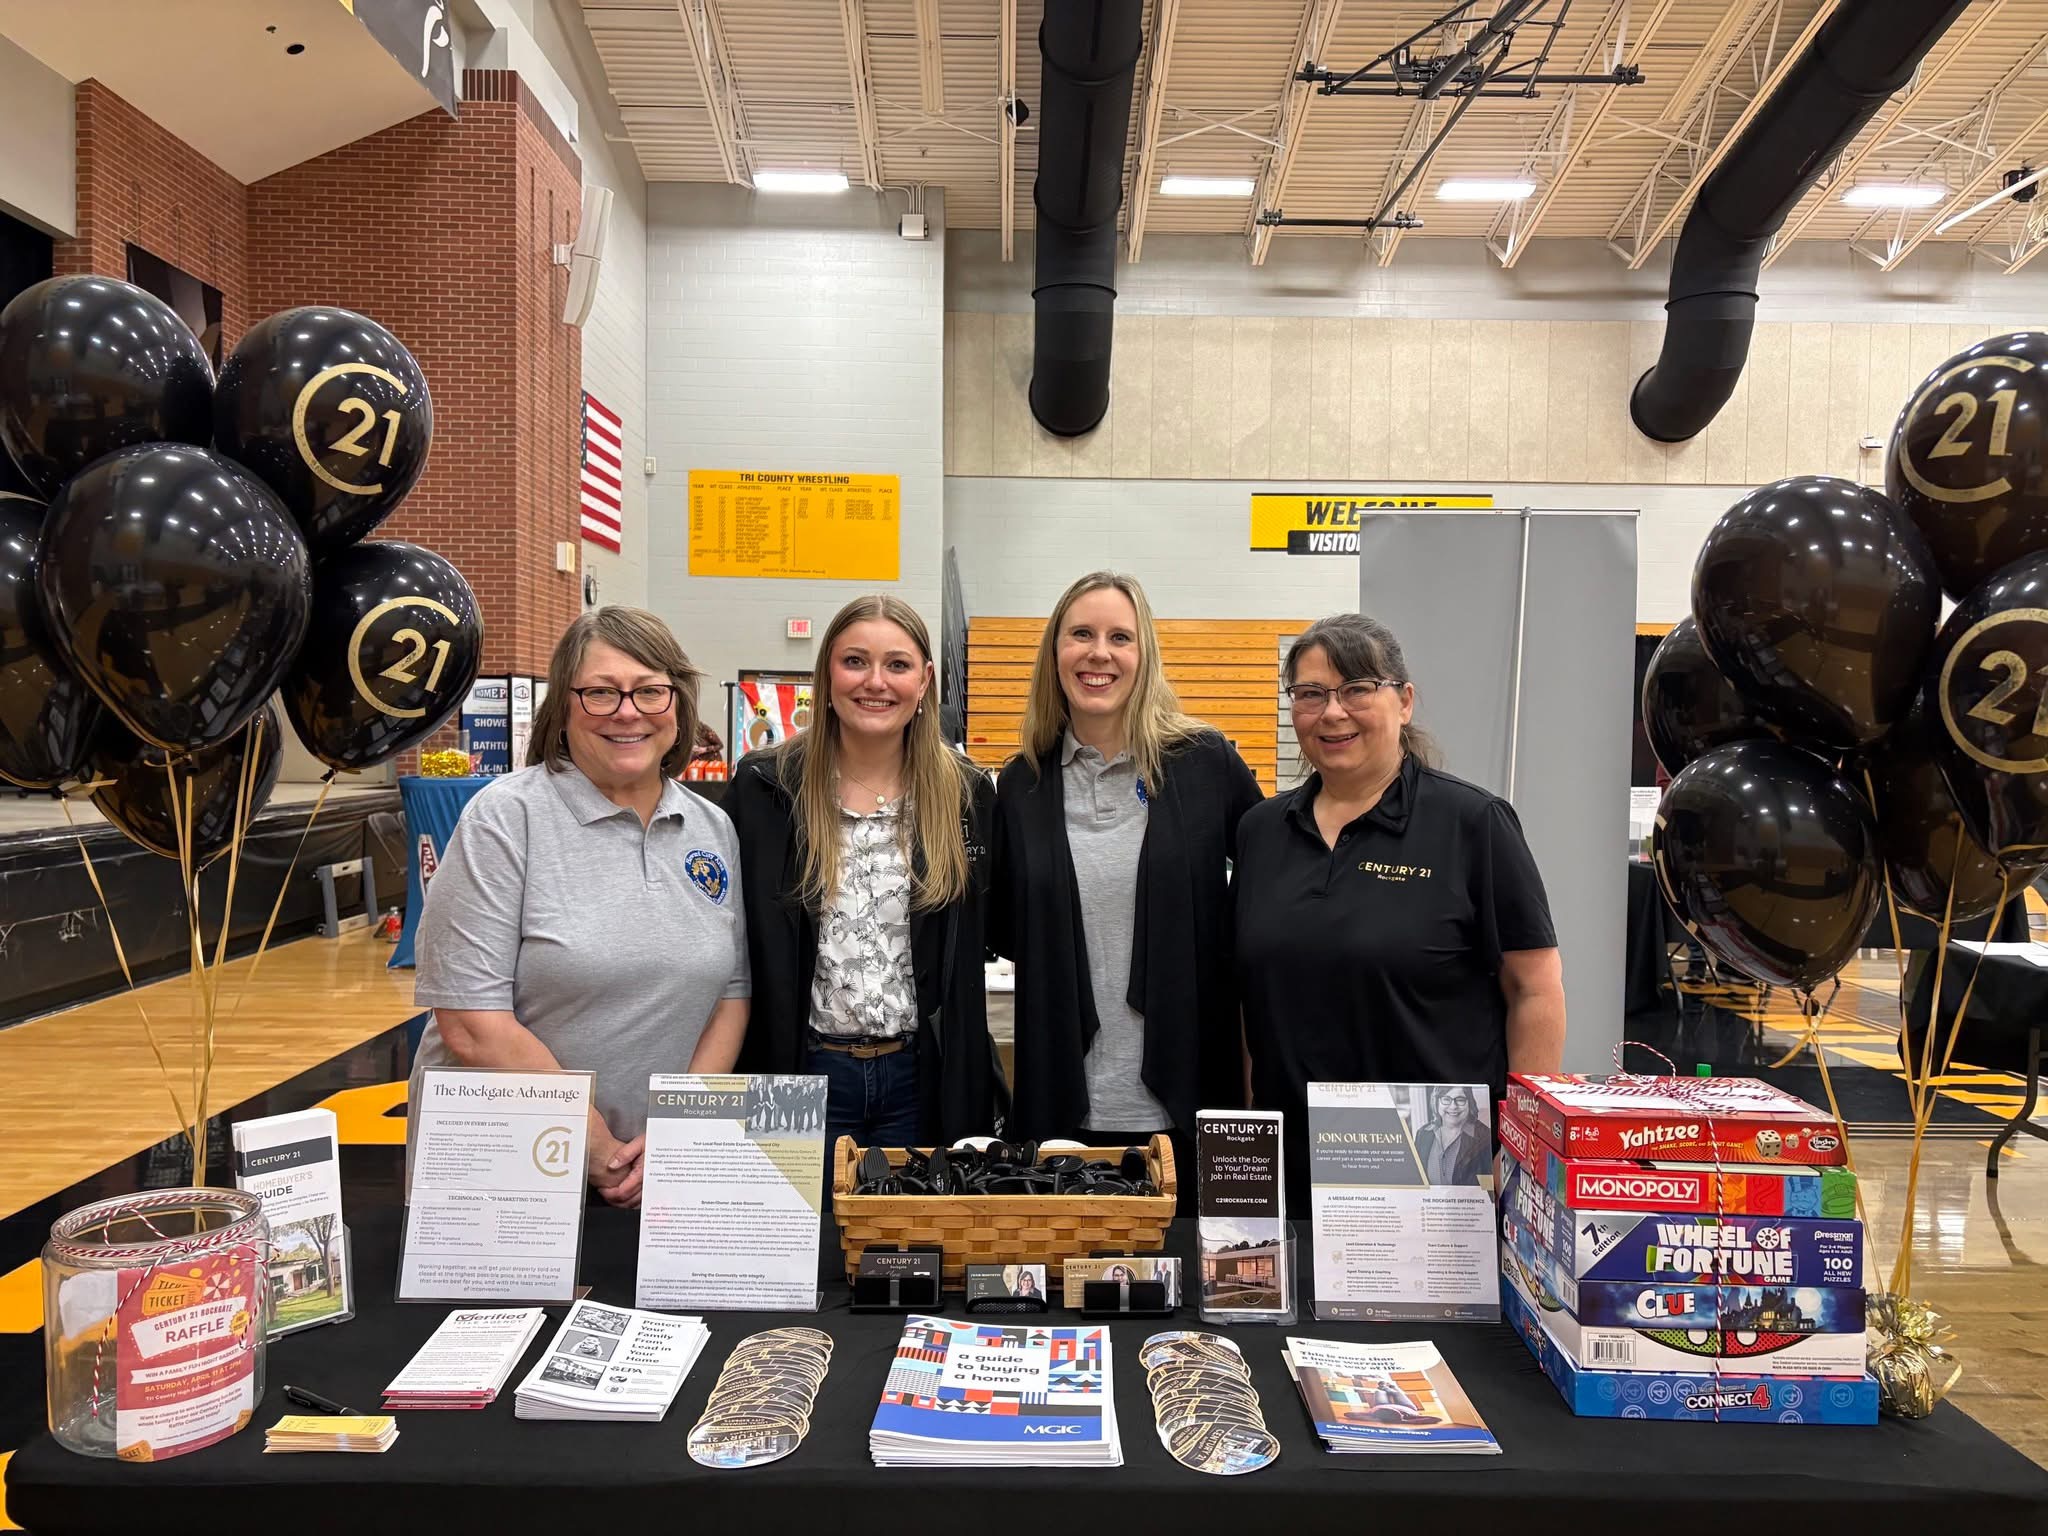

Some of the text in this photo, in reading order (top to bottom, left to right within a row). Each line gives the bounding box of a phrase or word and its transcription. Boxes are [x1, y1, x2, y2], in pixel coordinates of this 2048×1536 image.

[740, 474, 850, 484] TRI COUNTY WRESTLING
[1309, 533, 1360, 552] VISITO
[792, 622, 808, 632] EXIT
[474, 719, 507, 728] SHOWE
[1358, 862, 1432, 878] CENTURY 21
[434, 1084, 580, 1102] The Rockgate Advantage
[1318, 1084, 1377, 1093] CENTURY 21
[658, 1094, 744, 1106] CENTURY 21
[684, 1108, 717, 1117] Rockgate
[1203, 1123, 1278, 1135] CENTURY 21
[1570, 1131, 1580, 1140] 8+
[1317, 1133, 1403, 1144] JOIN OUR TEAM!
[1619, 1124, 1699, 1151] Yahtzee
[251, 1151, 301, 1167] CENTURY 21
[1212, 1156, 1271, 1164] Unlock the Door
[253, 1171, 313, 1191] HOMEBUYER'S
[1211, 1173, 1223, 1181] Job
[1224, 1173, 1231, 1181] in
[1233, 1173, 1248, 1181] Real
[256, 1185, 293, 1200] GUIDE
[1581, 1178, 1695, 1199] MONOPOLY
[1657, 1224, 1752, 1249] WHEEL
[1814, 1231, 1854, 1241] pressman
[1592, 1230, 1621, 1258] Edition
[1655, 1247, 1793, 1276] FORTUNE
[1824, 1258, 1853, 1270] 100
[150, 1294, 185, 1308] TICKET
[1636, 1290, 1695, 1319] CLUE
[154, 1304, 233, 1331] CENTURY 21 ROCKGATE
[643, 1320, 682, 1328] Protect
[166, 1317, 225, 1343] RAFFLE
[638, 1332, 674, 1340] Family
[975, 1353, 1024, 1365] guide
[165, 1367, 188, 1376] FAMILY
[201, 1357, 218, 1367] NIGHT
[620, 1366, 643, 1374] EPA
[957, 1363, 1040, 1376] to buying
[144, 1379, 189, 1393] SATURDAY,
[191, 1373, 210, 1383] APRIL
[219, 1367, 228, 1375] AT
[229, 1360, 242, 1370] 2PM
[972, 1373, 1021, 1384] home
[155, 1391, 176, 1400] County
[177, 1388, 190, 1396] High
[192, 1382, 210, 1393] School
[1686, 1393, 1752, 1408] CONNECT
[723, 1430, 780, 1443] CENTURY
[1024, 1425, 1082, 1435] MGIC
